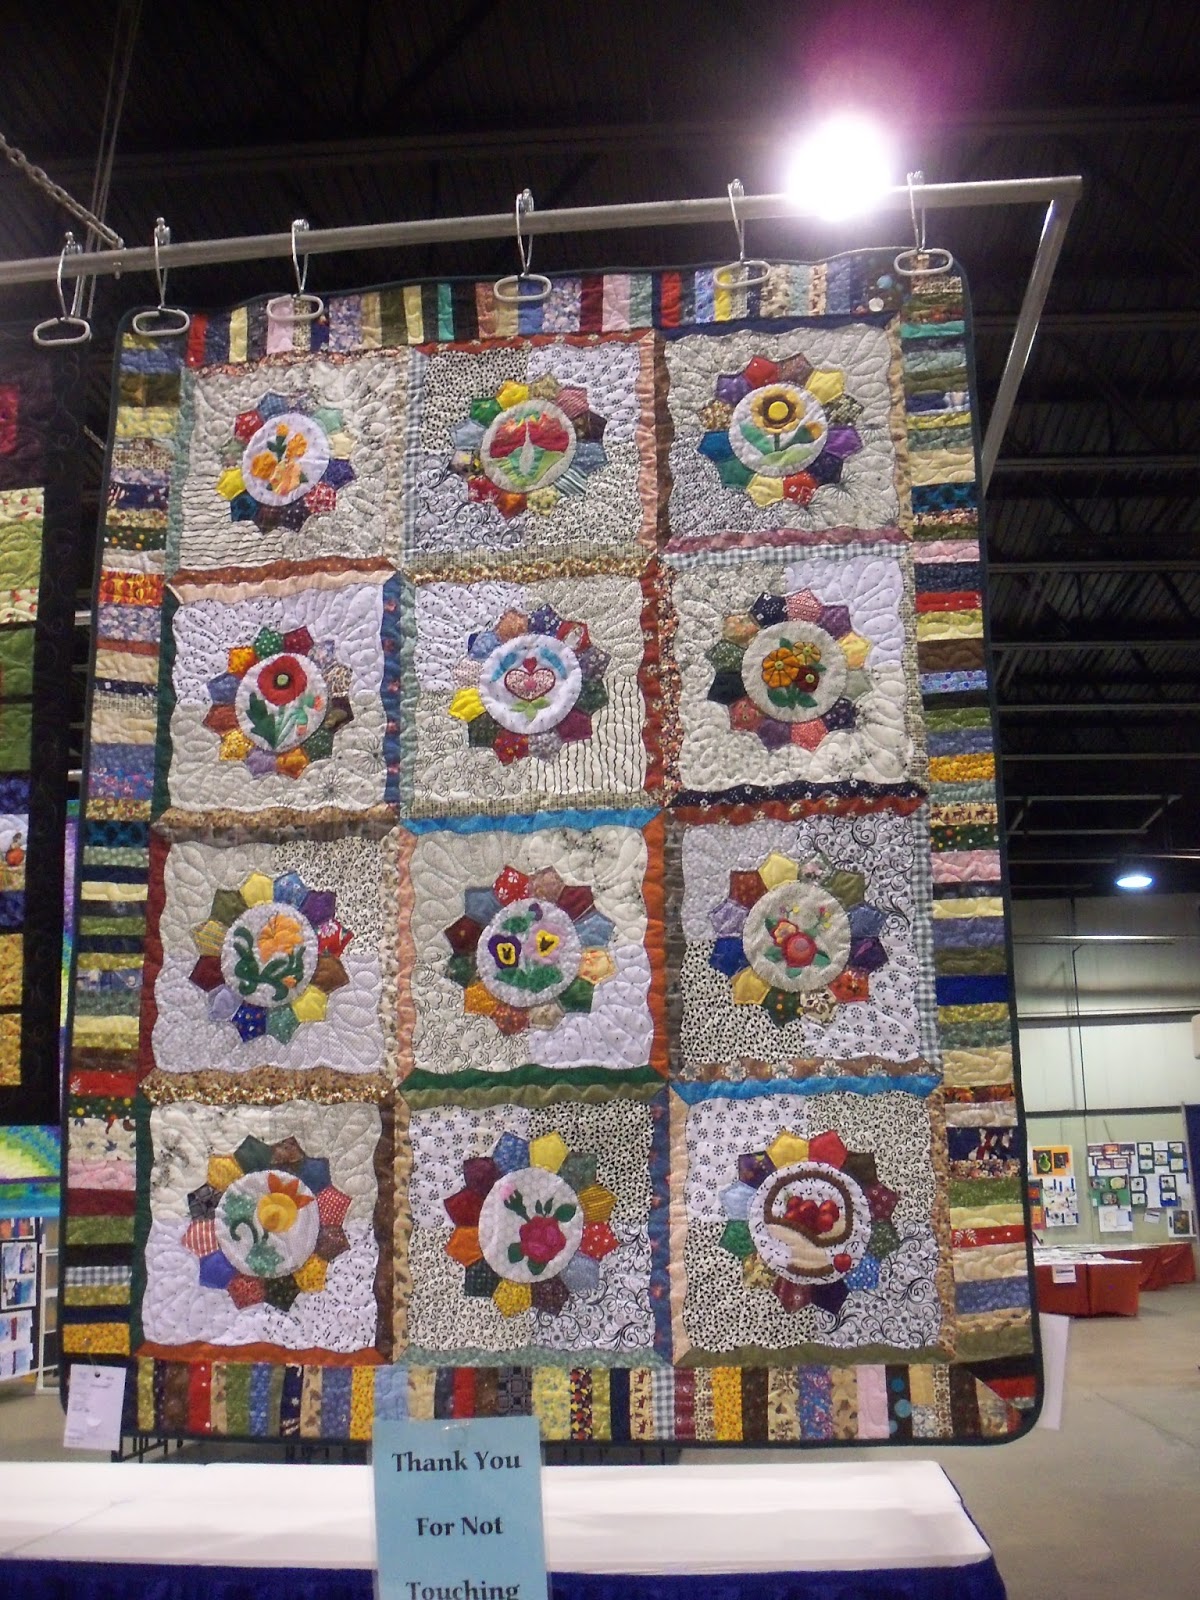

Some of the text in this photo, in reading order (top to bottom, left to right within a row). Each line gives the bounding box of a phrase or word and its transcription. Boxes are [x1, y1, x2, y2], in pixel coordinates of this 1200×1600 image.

[392, 1450, 522, 1472] Thank You
[416, 1516, 503, 1536] For Not
[405, 1580, 520, 1600] Touching
